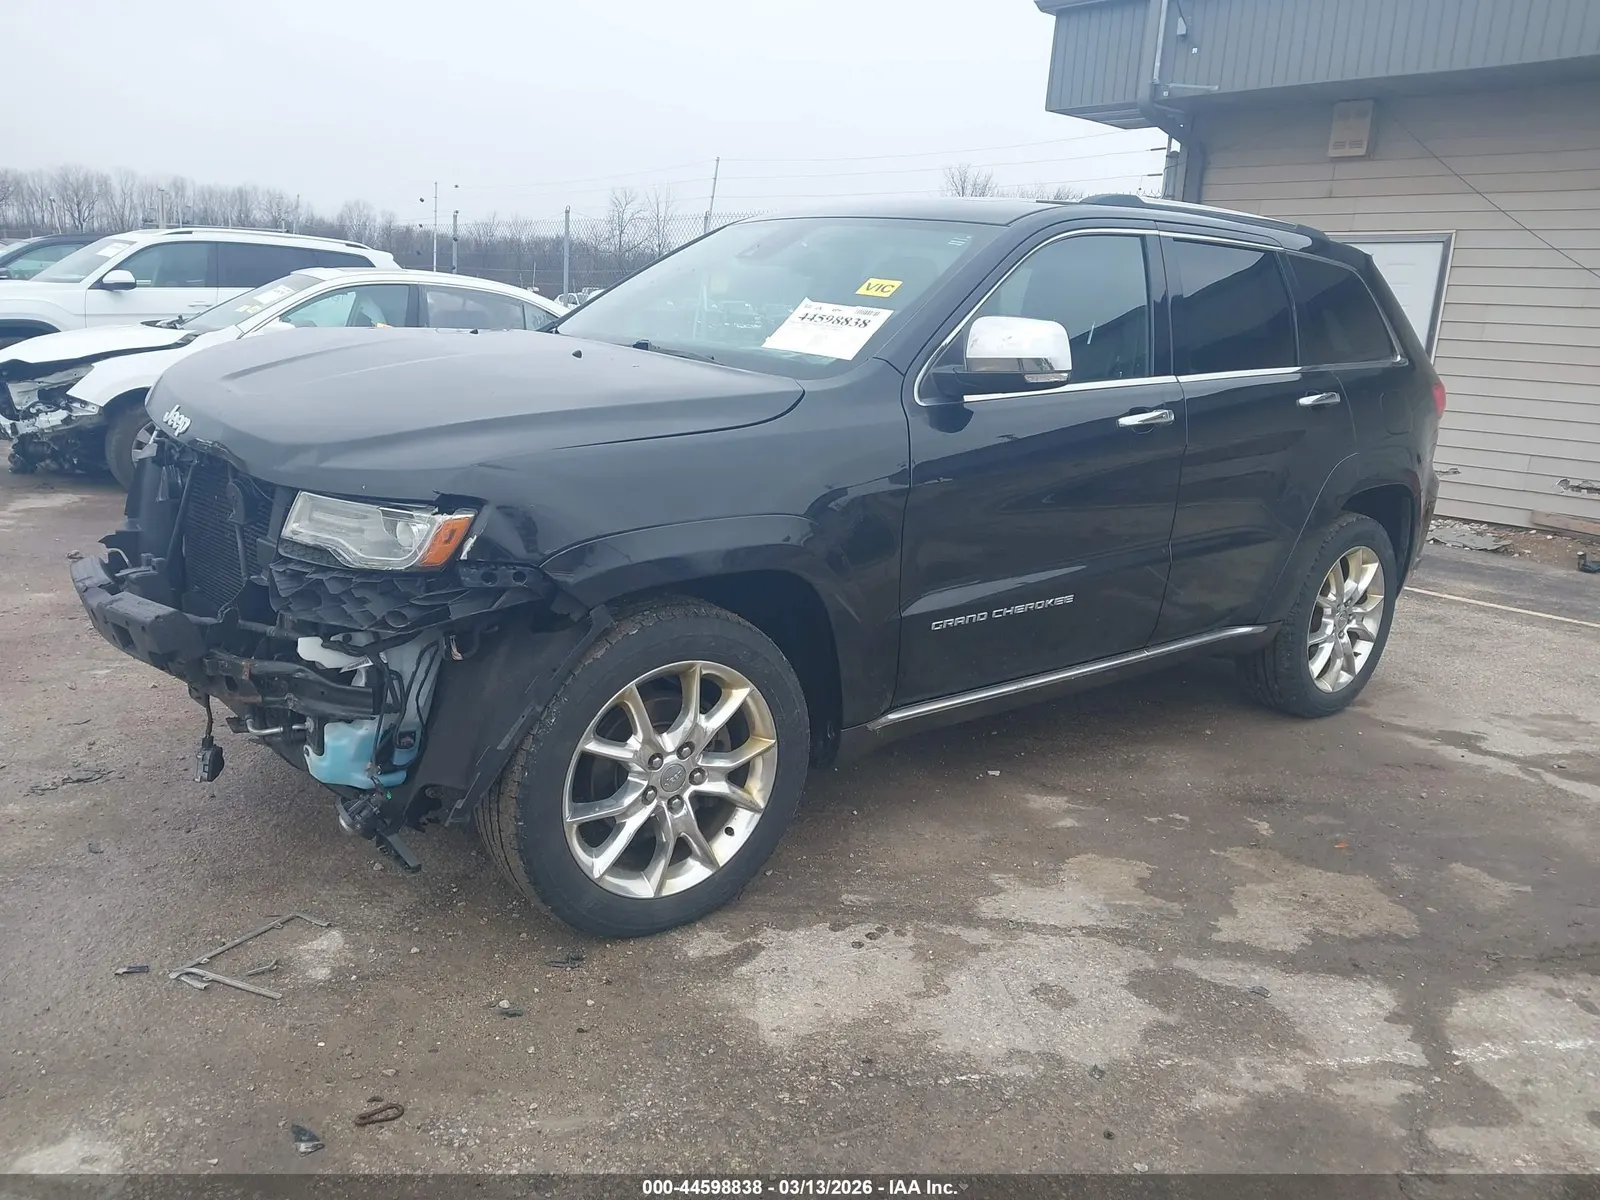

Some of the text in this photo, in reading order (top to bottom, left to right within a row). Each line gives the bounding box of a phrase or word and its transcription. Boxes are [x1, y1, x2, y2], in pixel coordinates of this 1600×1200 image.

[864, 281, 896, 294] VIC
[798, 312, 871, 328] 44598838
[163, 404, 191, 437] Jeep
[931, 594, 1075, 631] GRAND CHEROKEE
